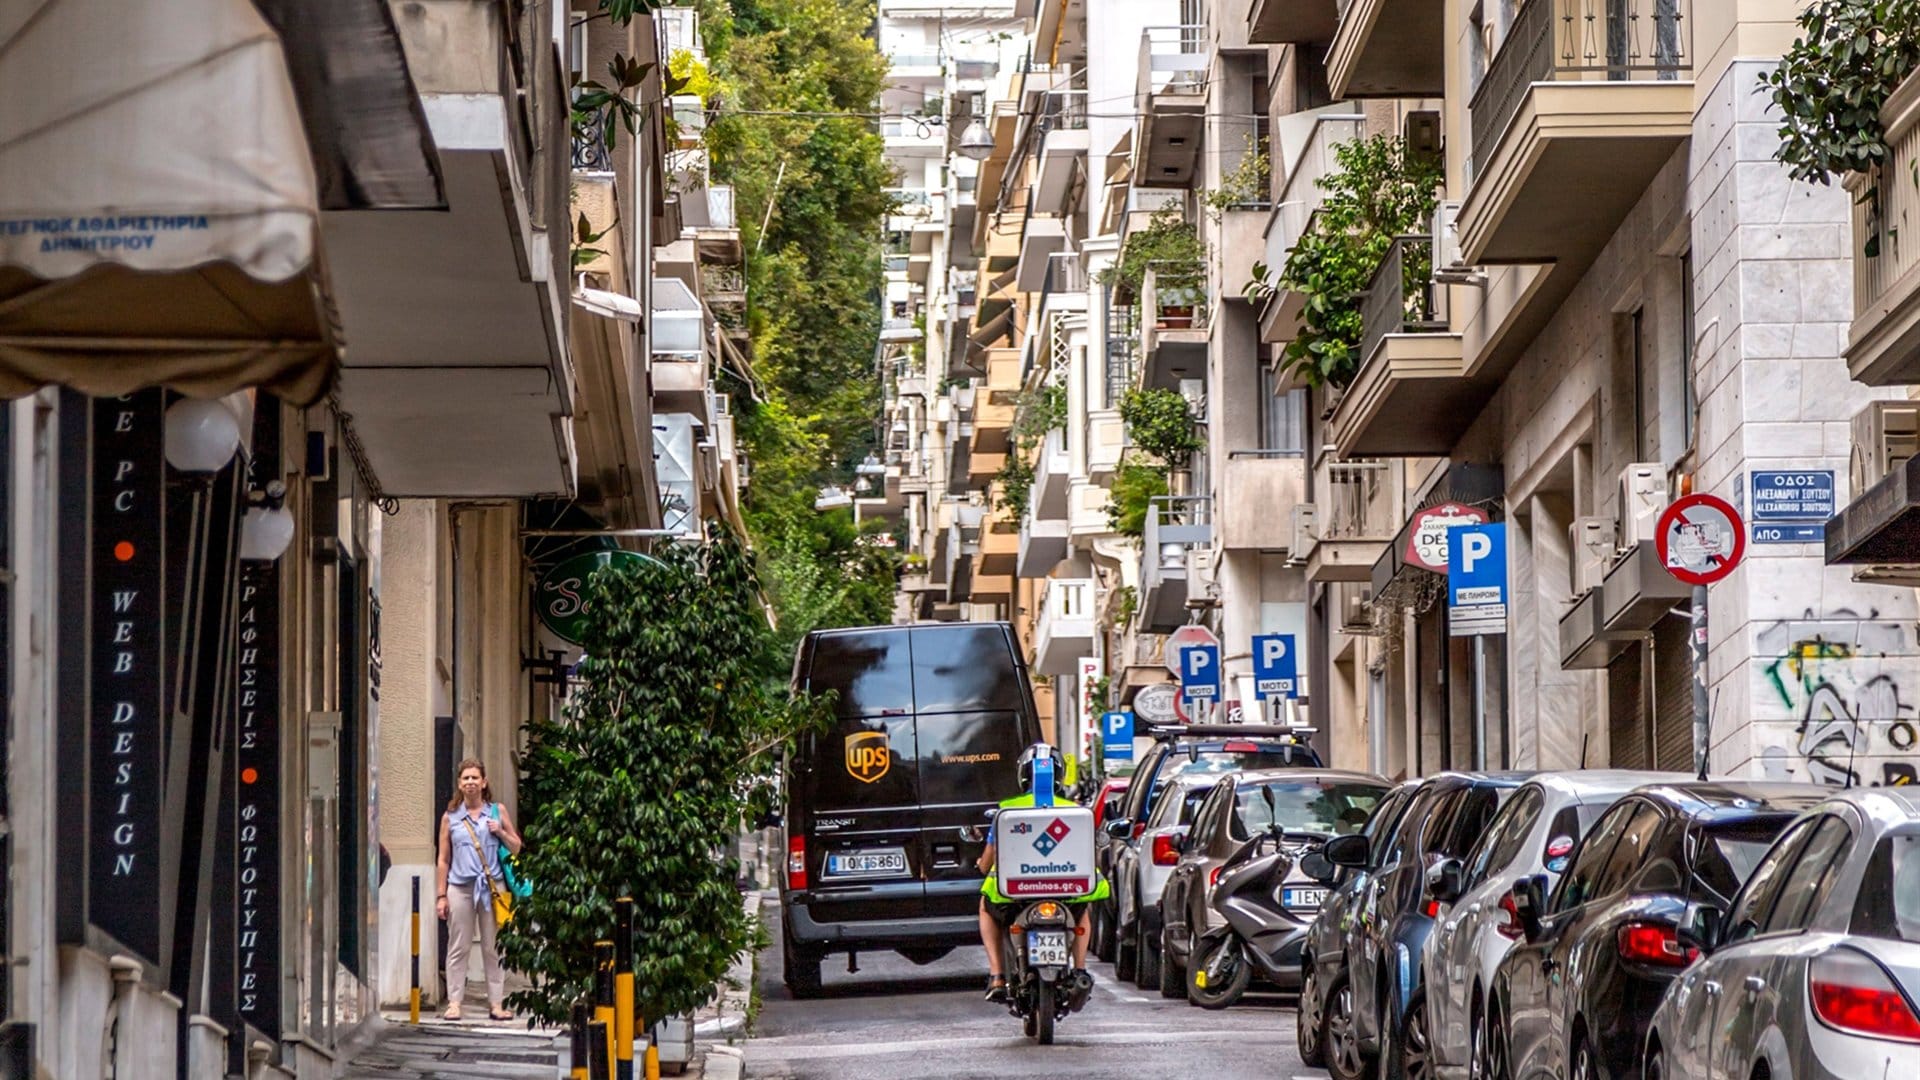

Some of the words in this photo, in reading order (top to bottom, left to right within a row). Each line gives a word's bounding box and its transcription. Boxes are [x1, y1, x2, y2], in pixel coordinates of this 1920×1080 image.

[40, 235, 155, 252] ΔΗΜΗΤΡΙΟΥ
[114, 461, 134, 512] PC
[1774, 475, 1815, 486] ΟΔΟΣ
[1756, 488, 1799, 499] ΑΛΕΞΑΝΔΡΟΥ
[1802, 488, 1831, 499] ΣΟΥΤΣΟΥ
[1756, 502, 1800, 512] ALEXANDROU
[1802, 502, 1832, 512] SOUTSOU
[1422, 533, 1449, 545] DÉ
[1756, 529, 1781, 540] ΑΠΟ
[1462, 532, 1492, 573] P
[113, 591, 137, 673] WEB
[1262, 639, 1286, 668] P
[1189, 650, 1210, 676] P
[1188, 687, 1213, 695] MOTO
[1261, 680, 1289, 691] MOTO
[1109, 714, 1126, 735] P
[849, 745, 887, 775] ups
[940, 753, 1000, 764] www.ups.com
[112, 702, 135, 876] DESIGN
[816, 817, 856, 827] TRANSIT
[1020, 861, 1076, 874] Domino's
[1017, 882, 1073, 893] dominos.gr
[240, 804, 257, 1011] ΦΩΤΟΤΥΠΙΕΣ
